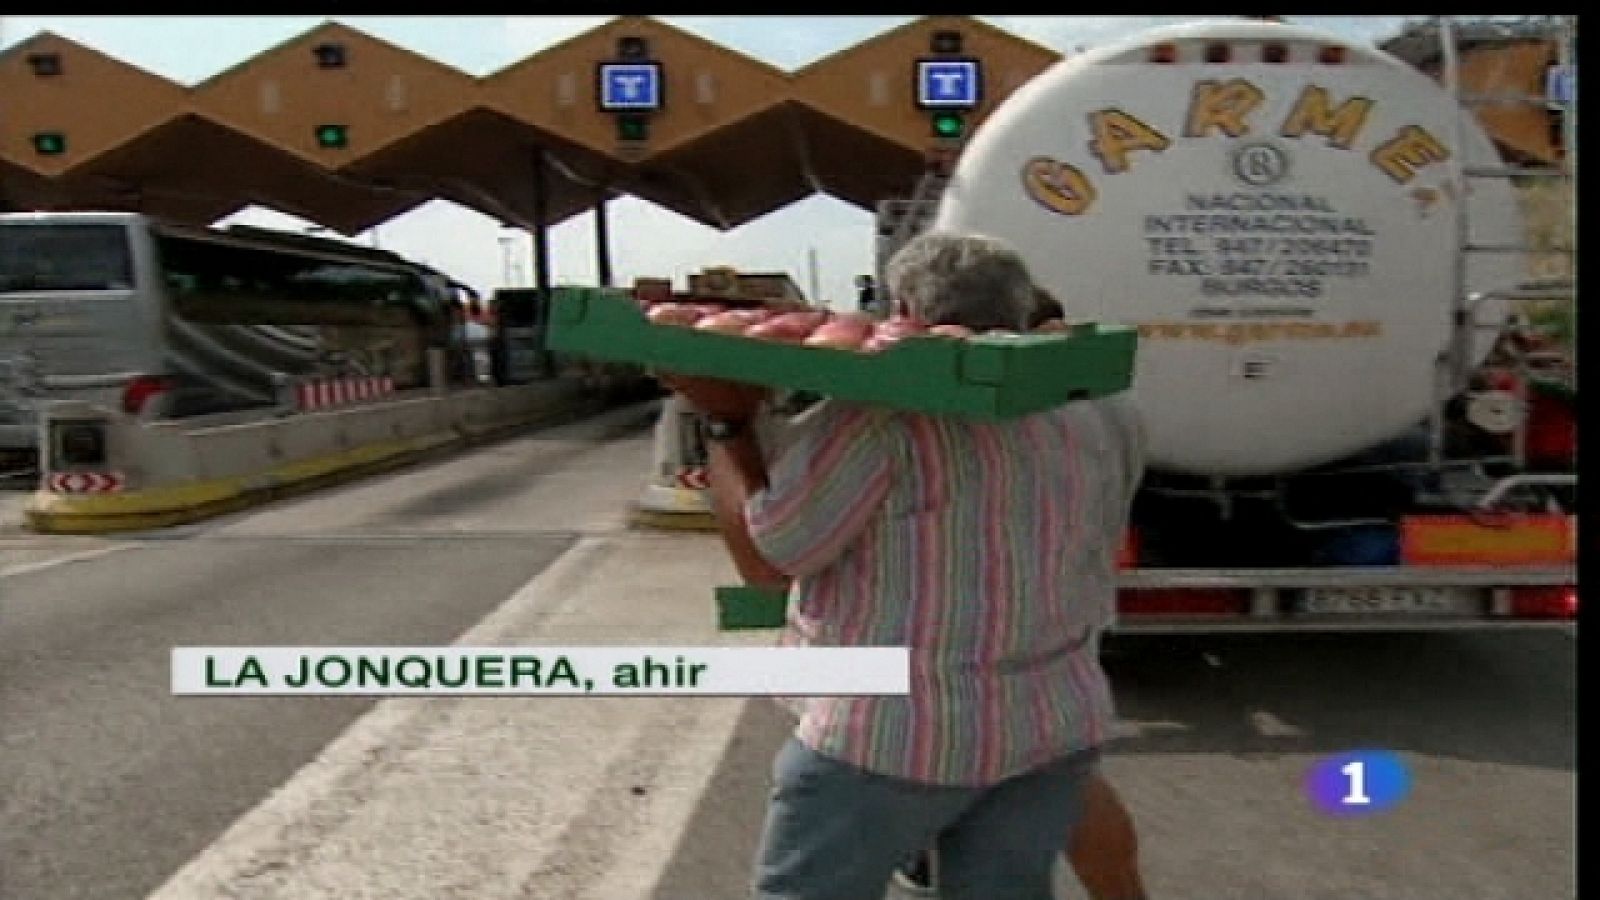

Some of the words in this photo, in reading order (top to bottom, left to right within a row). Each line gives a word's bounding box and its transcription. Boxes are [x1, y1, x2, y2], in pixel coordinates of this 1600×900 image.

[1186, 192, 1337, 213] NACIONAL
[1144, 214, 1375, 236] INTERNACIONAL
[1202, 278, 1322, 298] BURGOS
